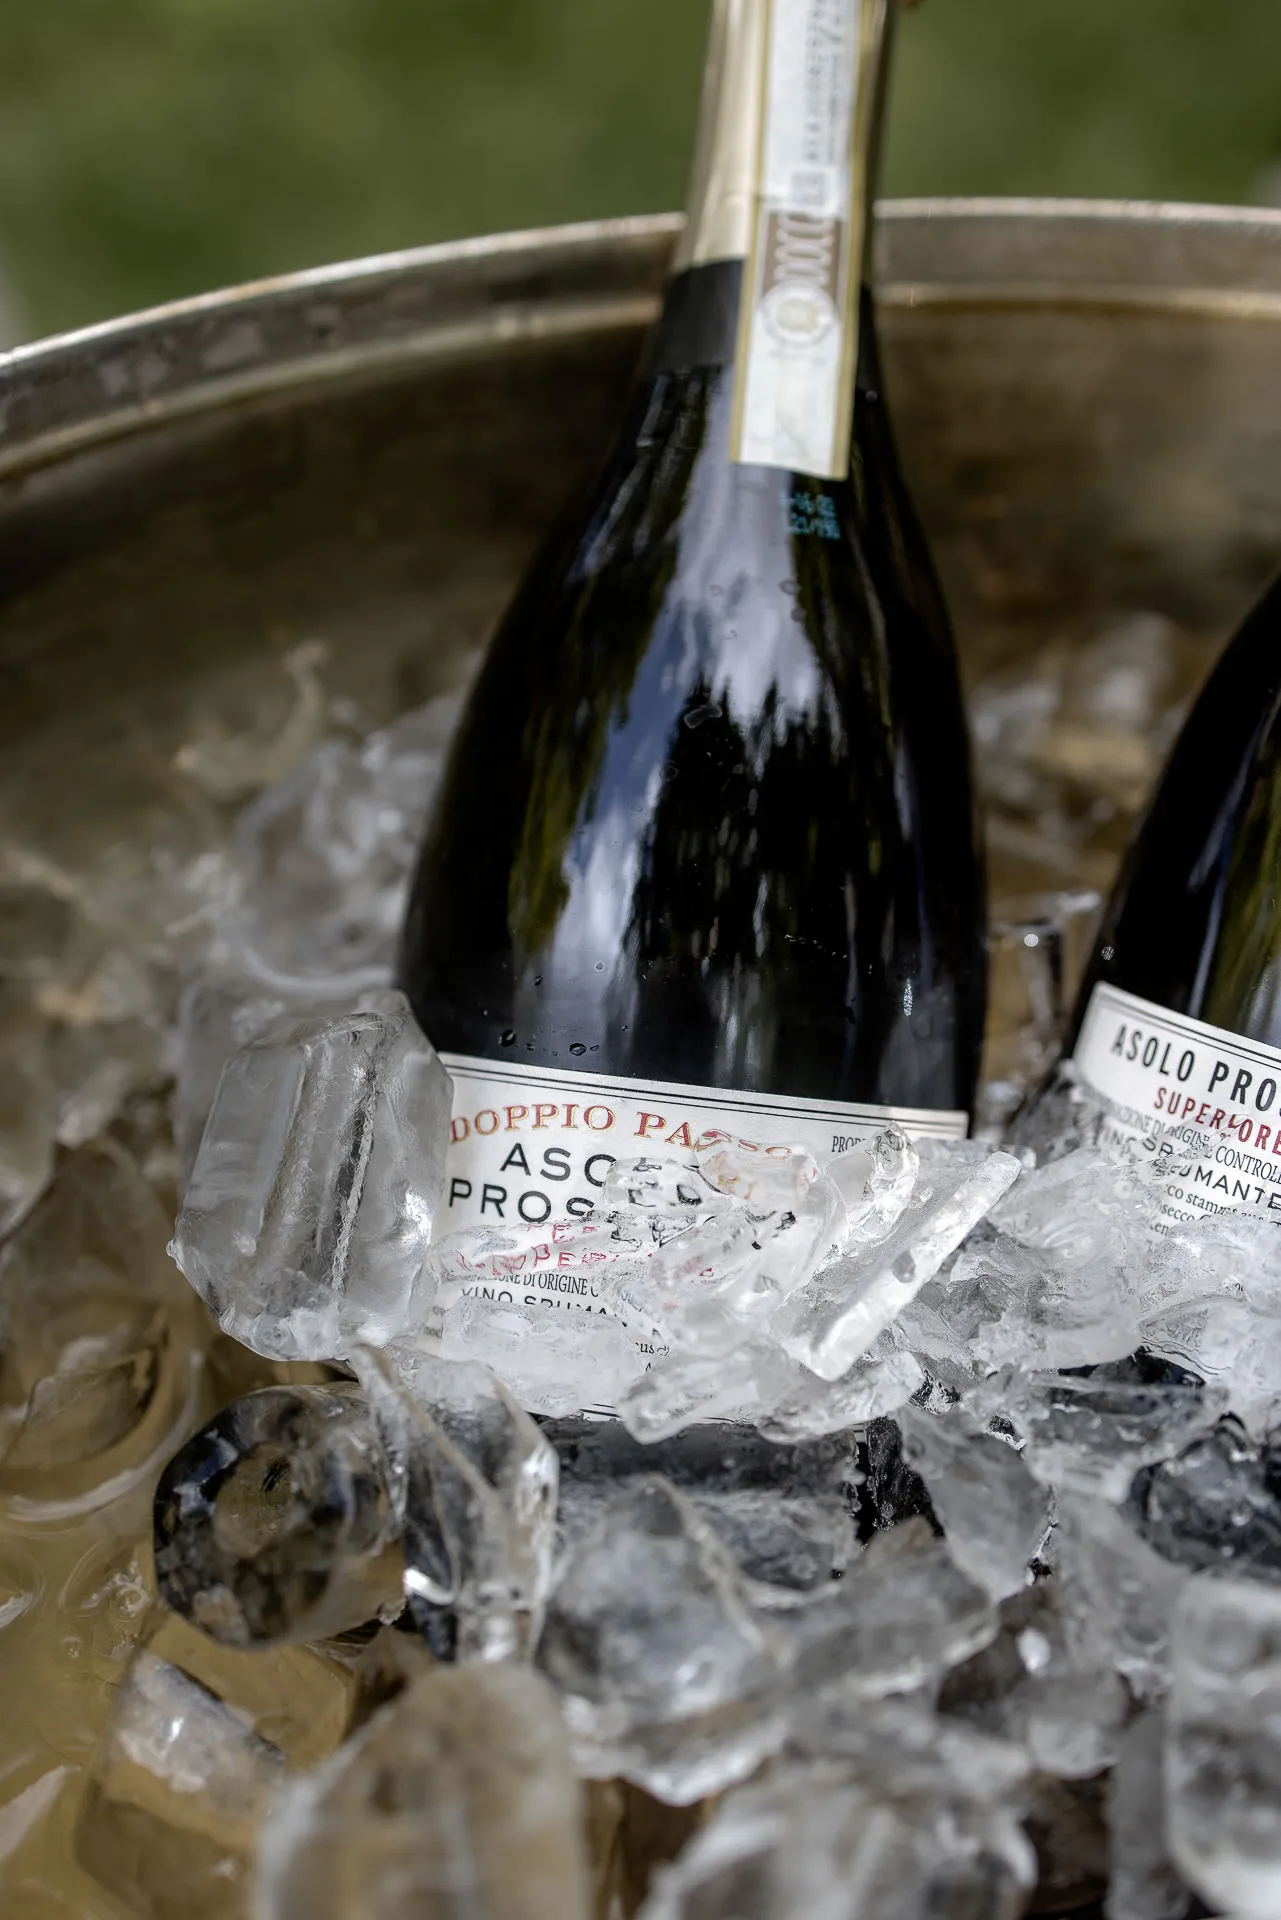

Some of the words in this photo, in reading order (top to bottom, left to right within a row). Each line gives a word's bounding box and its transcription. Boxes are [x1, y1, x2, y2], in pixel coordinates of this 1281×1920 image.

[1111, 1025, 1196, 1082] ASOLO
[1207, 1061, 1281, 1117] PRO
[450, 1103, 616, 1145] DOPPIO
[448, 1177, 596, 1224] PROS
[538, 1273, 588, 1296] ORIGINE
